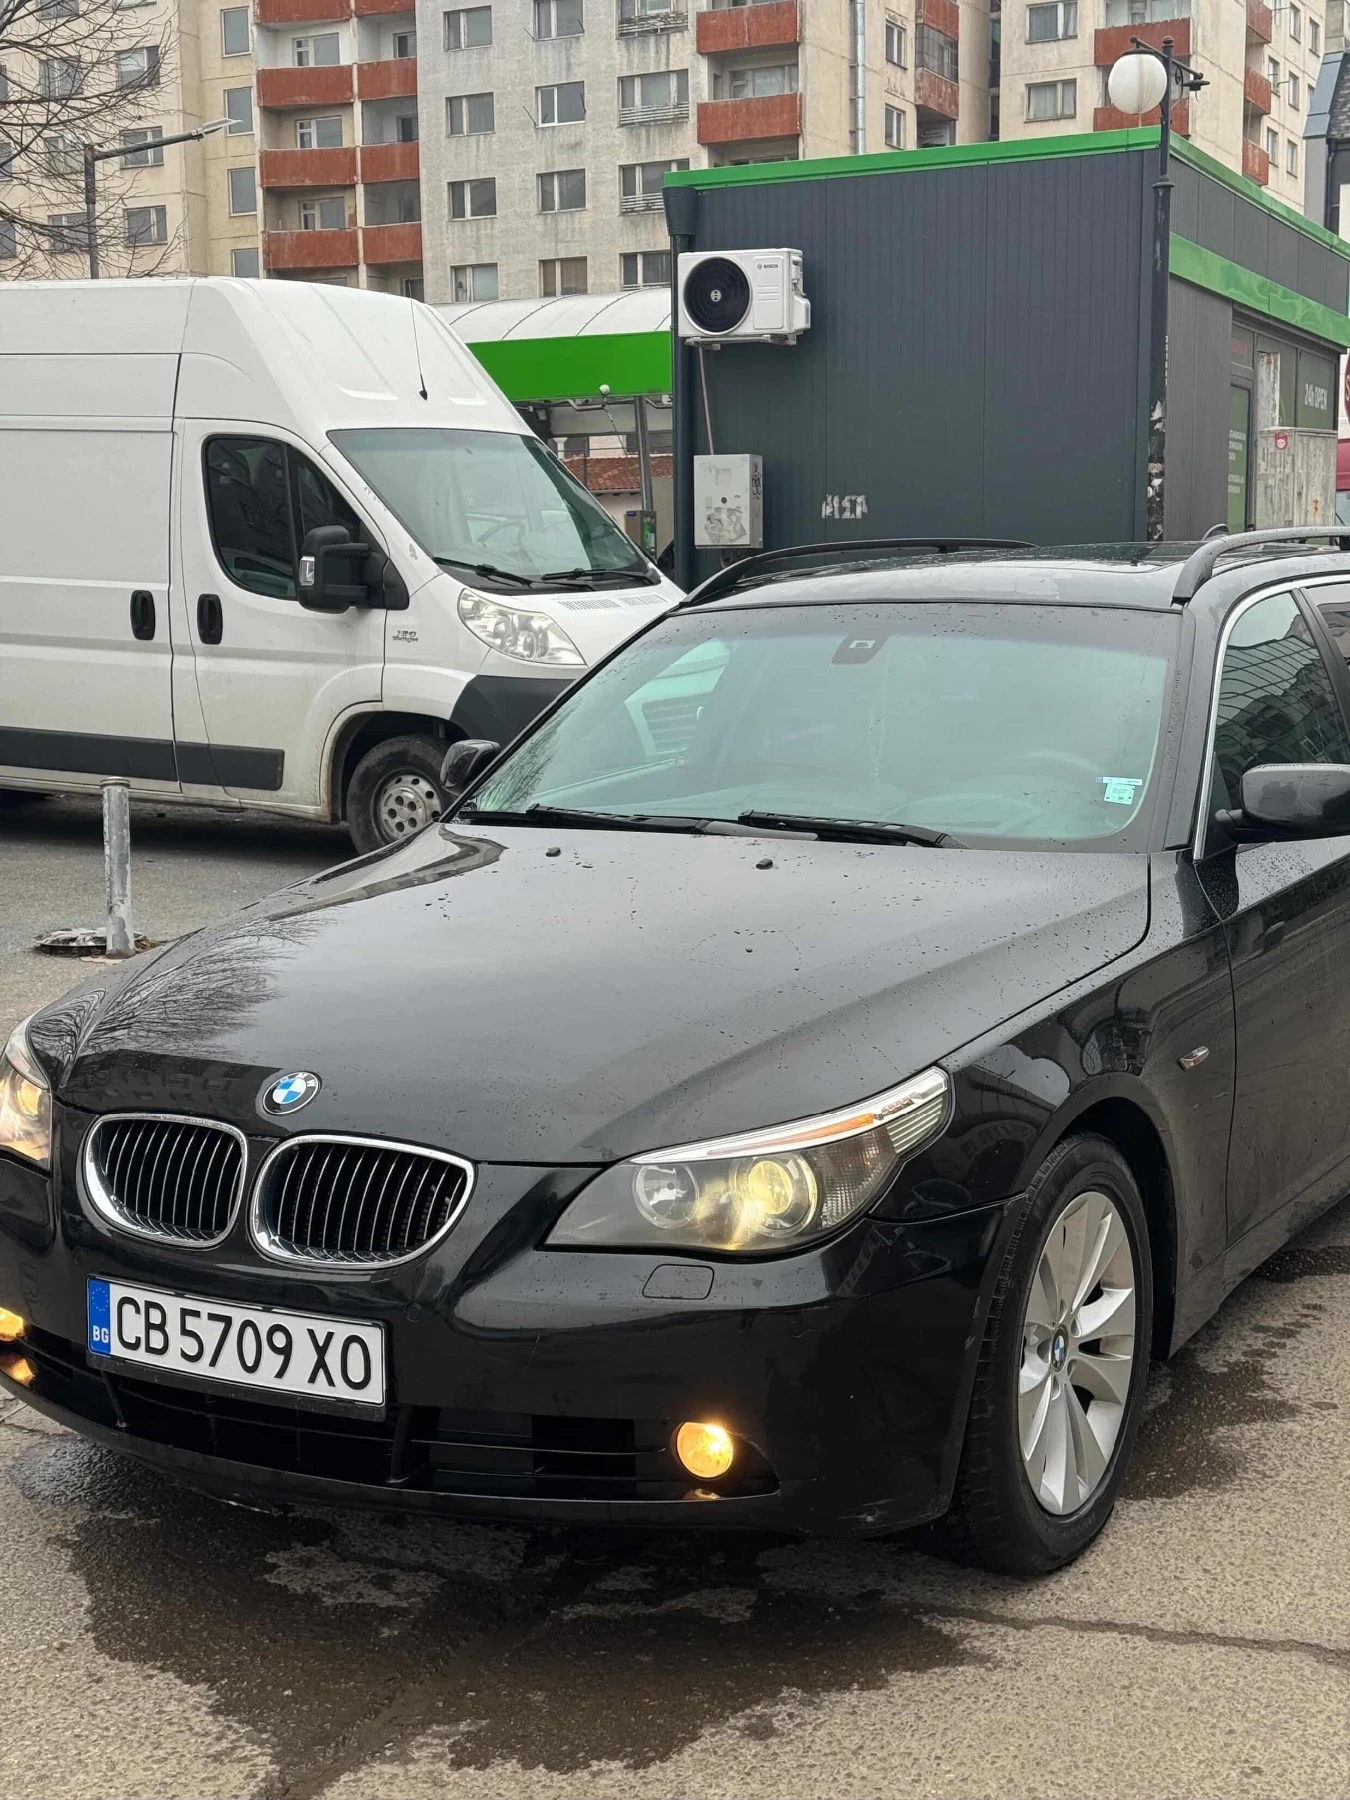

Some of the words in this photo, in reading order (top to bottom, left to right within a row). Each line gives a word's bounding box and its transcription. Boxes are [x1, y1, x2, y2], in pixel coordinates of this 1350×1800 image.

[1314, 386, 1328, 410] OPEN
[92, 1325, 109, 1344] BG
[116, 1296, 170, 1356] CB
[179, 1307, 293, 1379] 5709
[306, 1328, 371, 1391] XO
